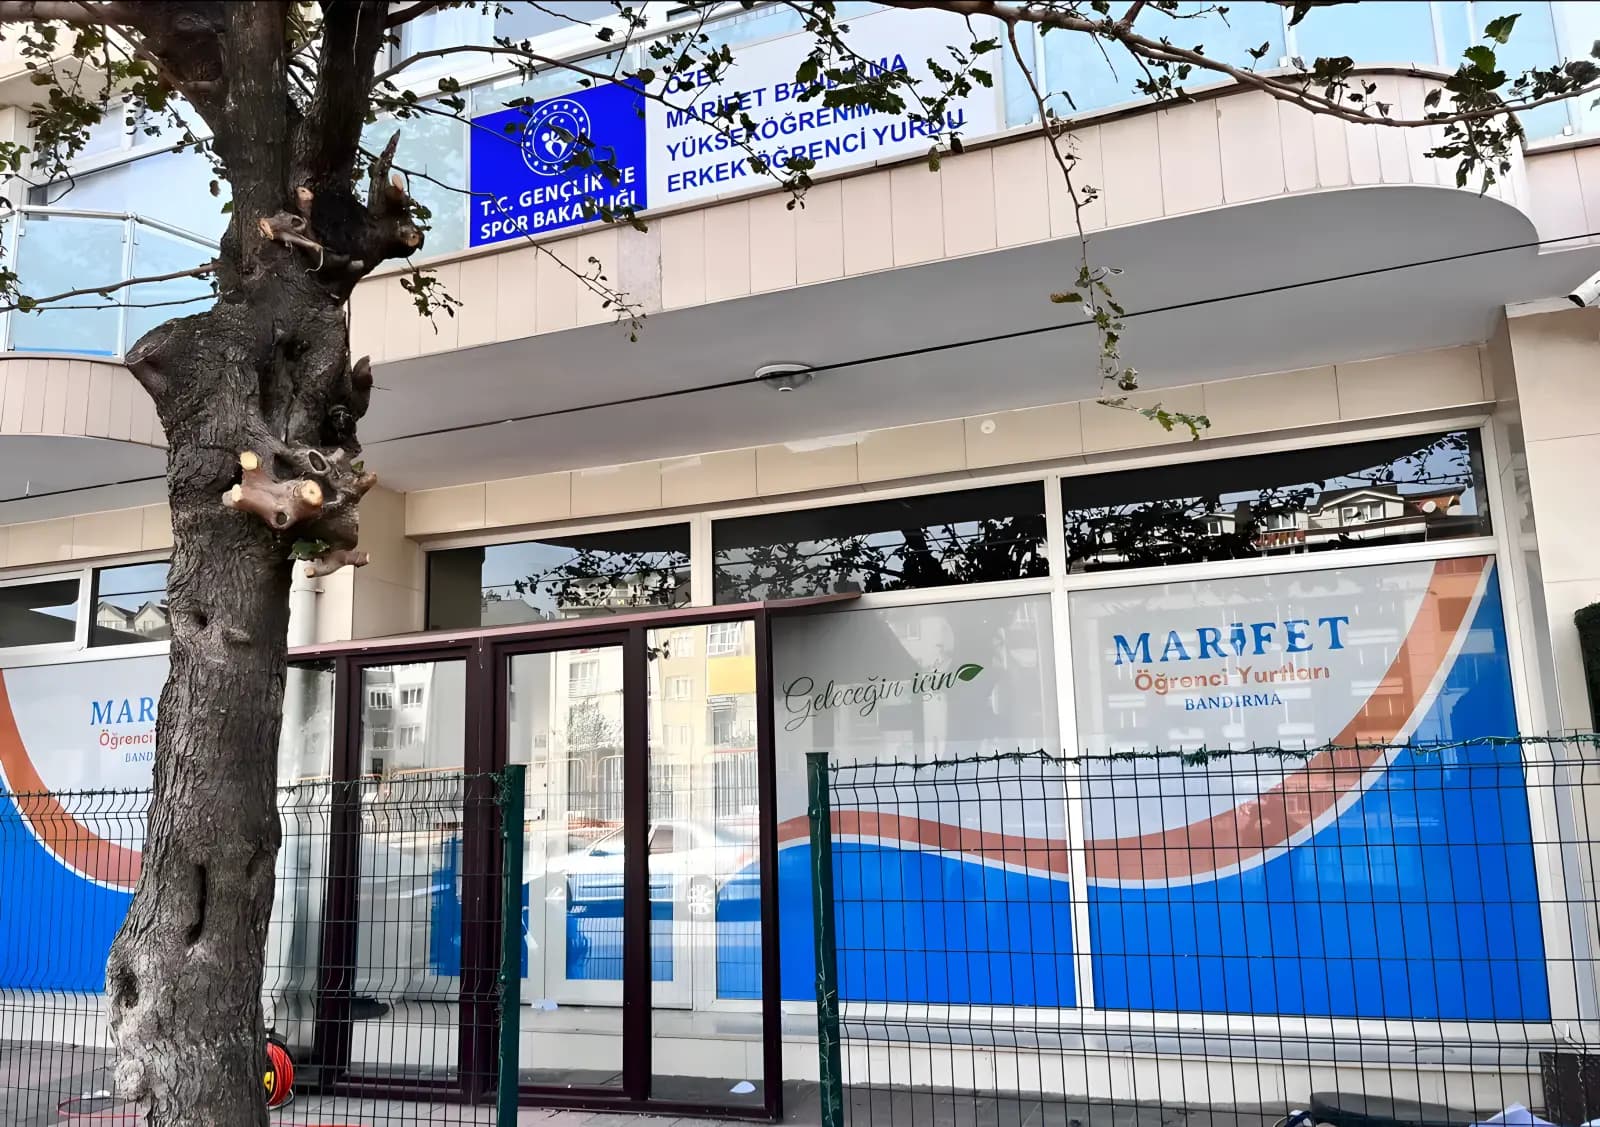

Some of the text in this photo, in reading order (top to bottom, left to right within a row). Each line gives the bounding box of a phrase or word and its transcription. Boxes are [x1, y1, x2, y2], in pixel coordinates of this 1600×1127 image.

[666, 65, 724, 94] ÖZE
[775, 54, 908, 102] BAMA
[667, 108, 963, 193] ERKEK ÖĞRENCİ YURDU
[480, 166, 635, 217] T.C. GENÇLİK E
[480, 215, 528, 240] SPOR
[1135, 662, 1330, 695] Öğrenci Yurtları
[782, 669, 957, 731] Geleceğin için
[1185, 693, 1282, 711] BANDIRMA
[99, 729, 154, 750] Öğrenci
